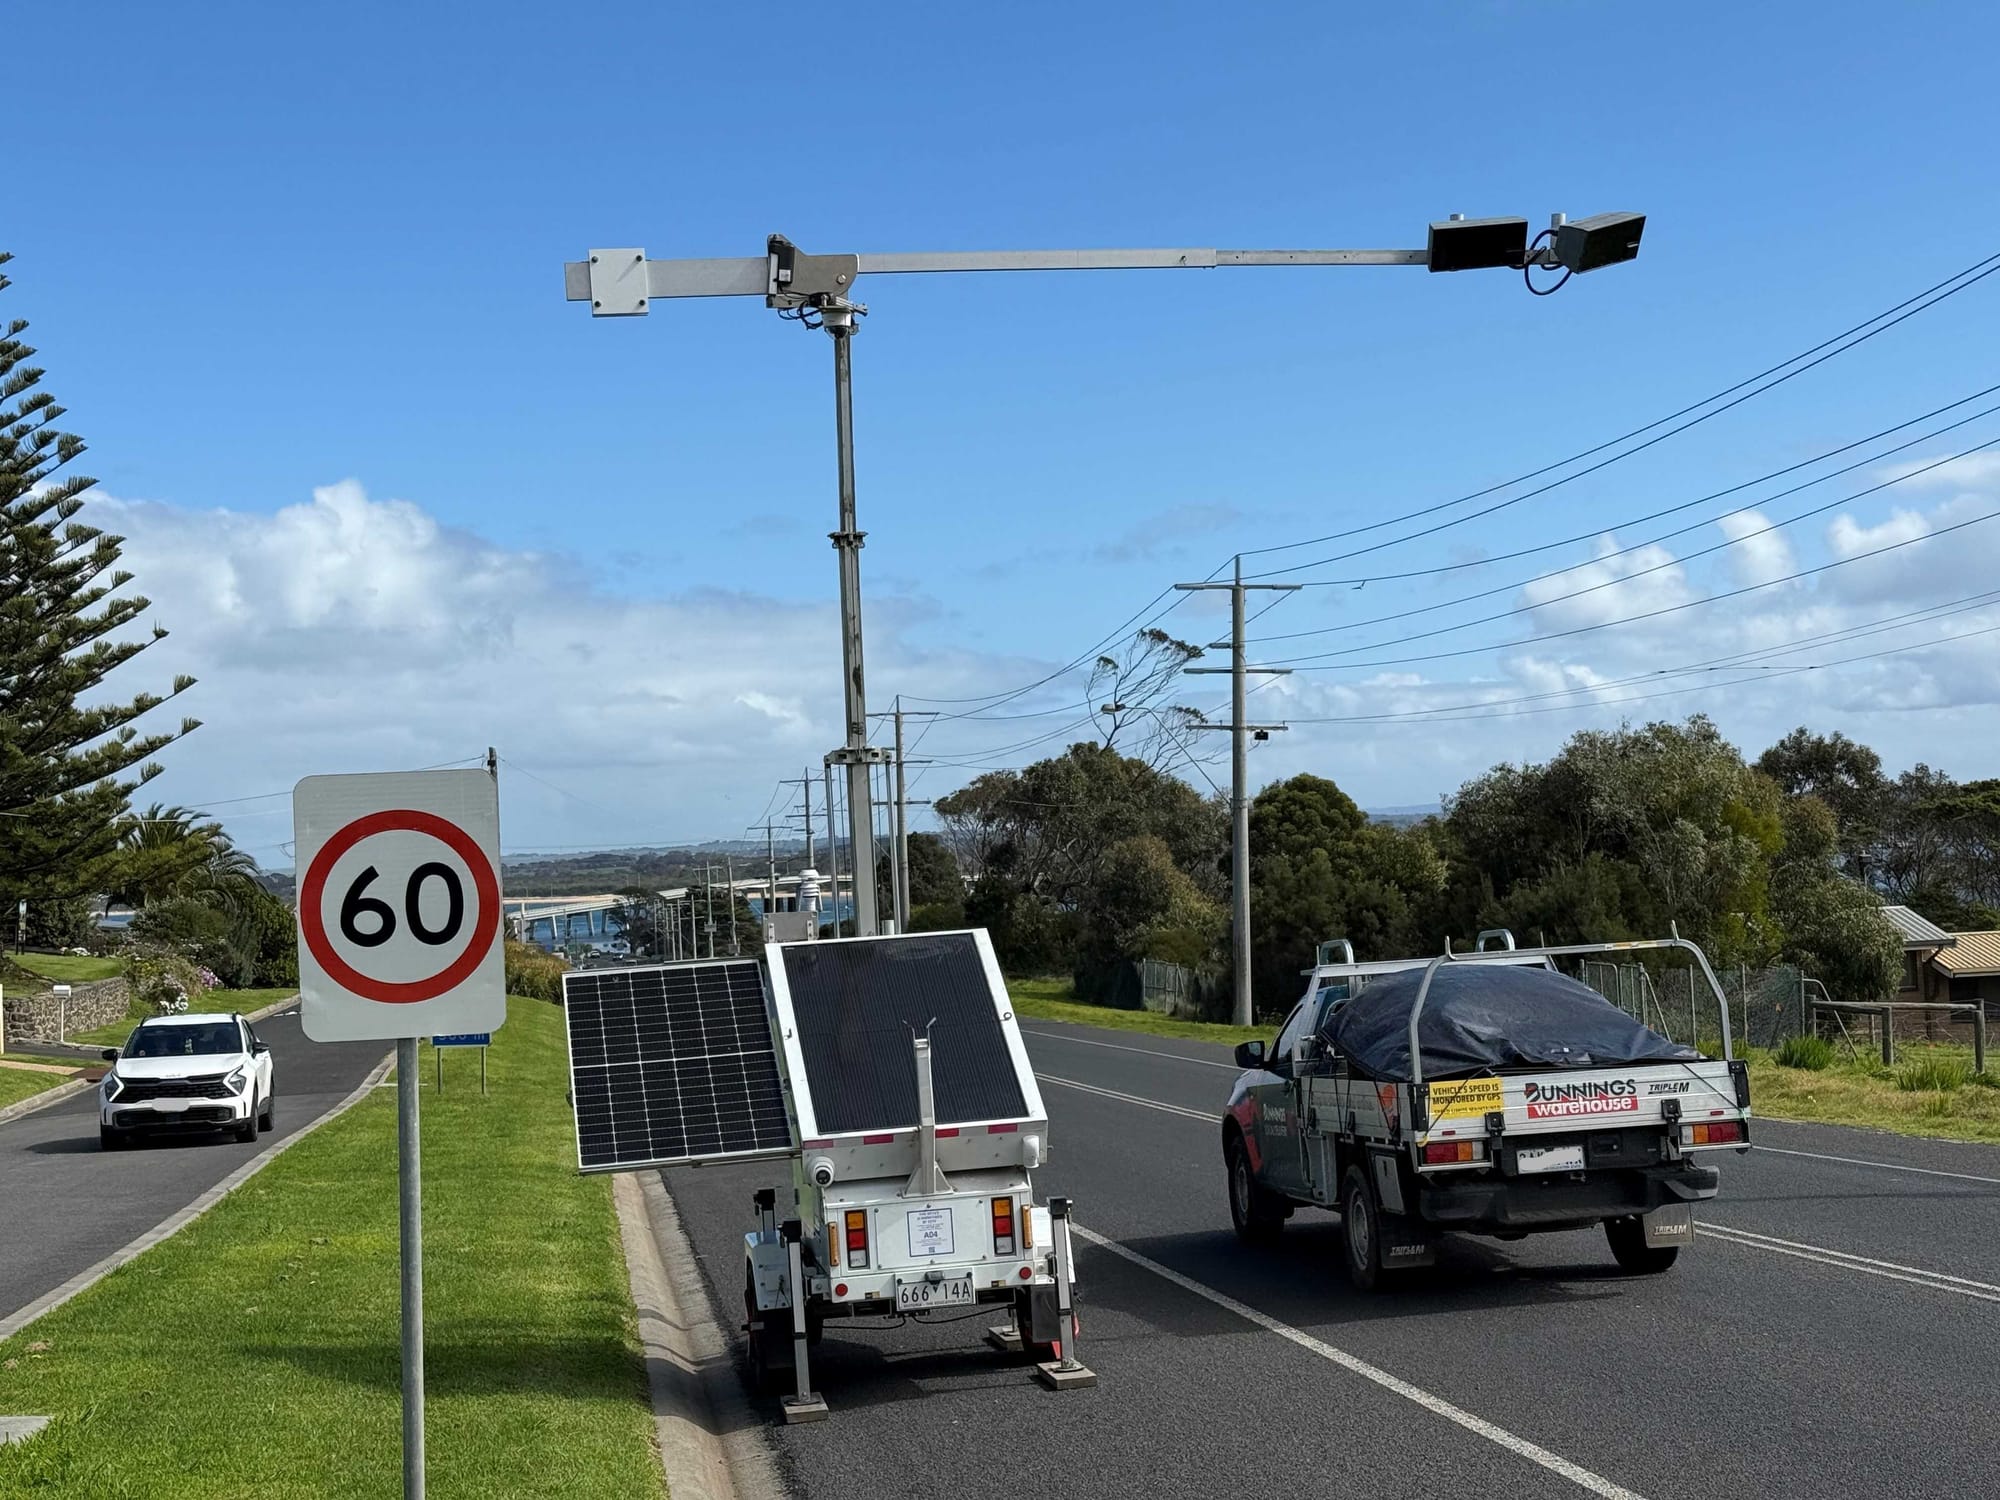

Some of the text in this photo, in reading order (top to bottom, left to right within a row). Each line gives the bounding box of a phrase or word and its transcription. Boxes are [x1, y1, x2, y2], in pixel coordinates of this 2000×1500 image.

[340, 862, 464, 947] 60
[1432, 1083, 1499, 1096] VEHICLES SPEED IS
[1476, 1094, 1486, 1102] BY
[1487, 1093, 1501, 1101] GPS
[1524, 1079, 1637, 1102] BUNNINGS
[1534, 1096, 1632, 1116] warehouse
[901, 1281, 971, 1303] 666 14A
